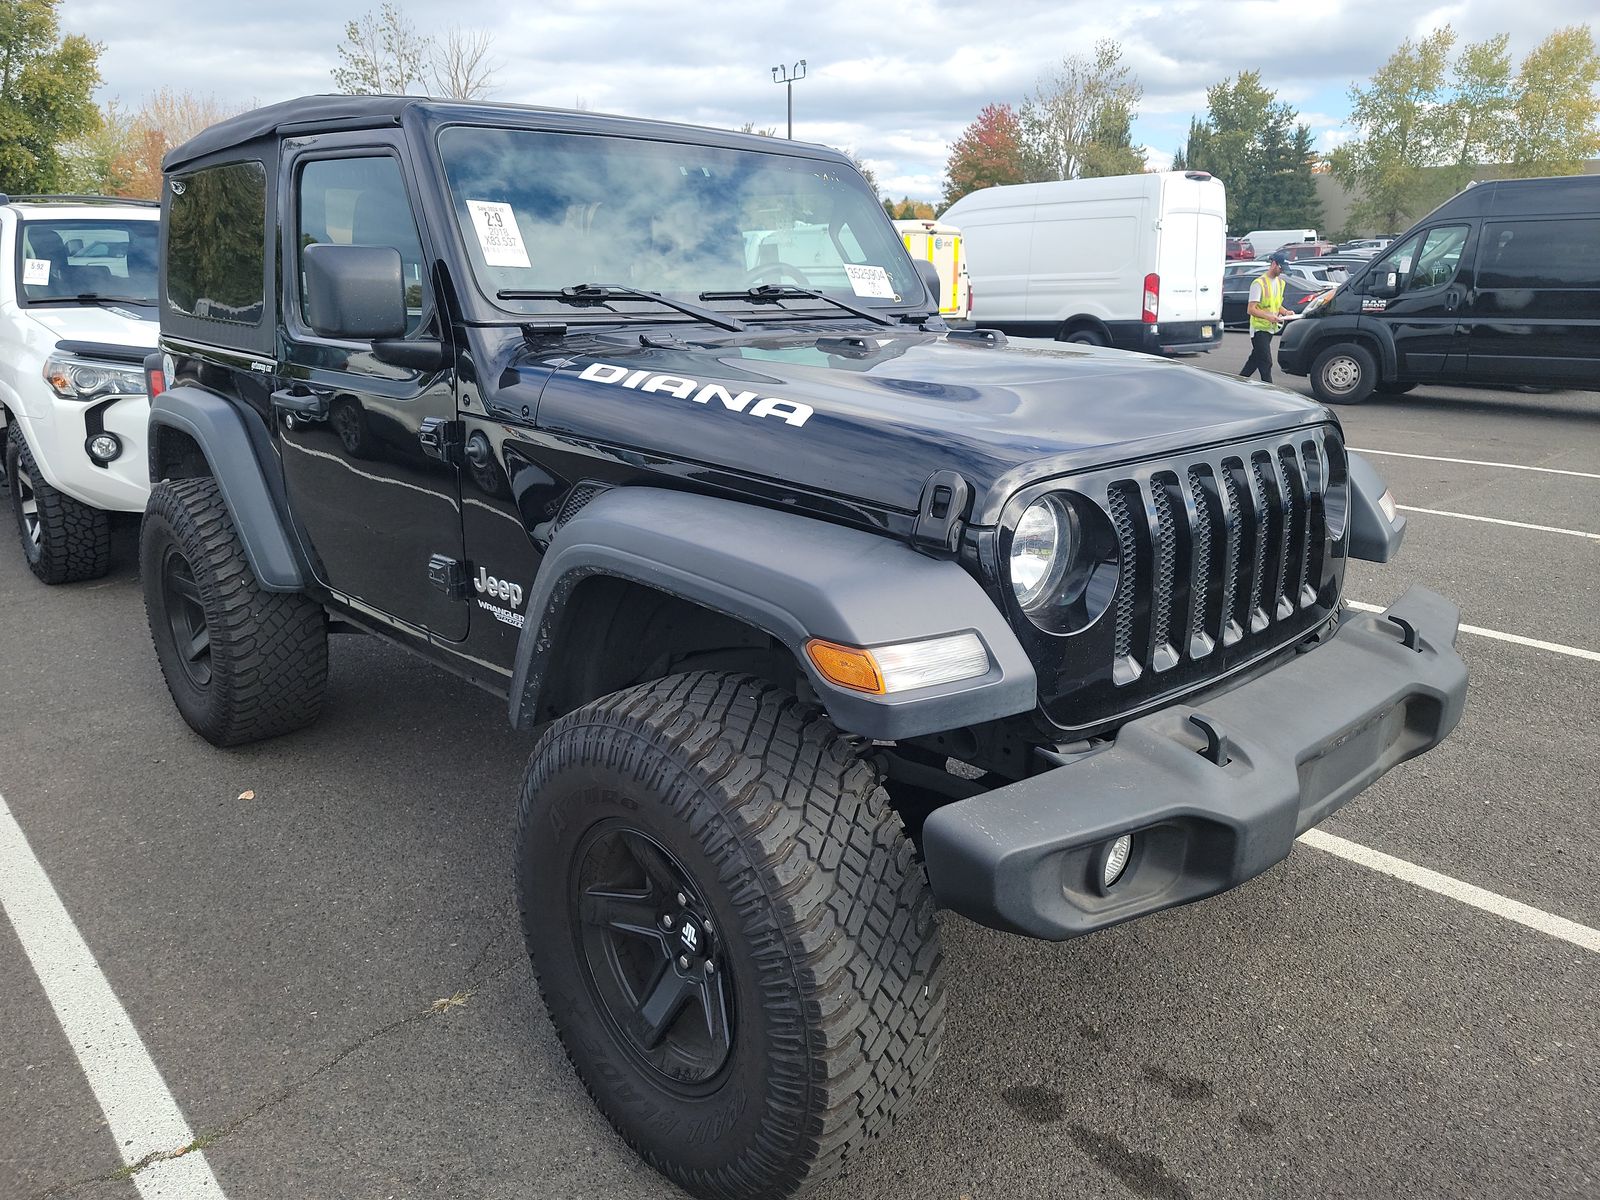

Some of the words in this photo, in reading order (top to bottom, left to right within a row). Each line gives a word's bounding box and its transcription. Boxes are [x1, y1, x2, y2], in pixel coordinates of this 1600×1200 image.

[484, 211, 503, 227] 2:9
[578, 363, 814, 427] DIANA
[473, 566, 523, 609] Jeep
[477, 599, 525, 622] WRANGLER
